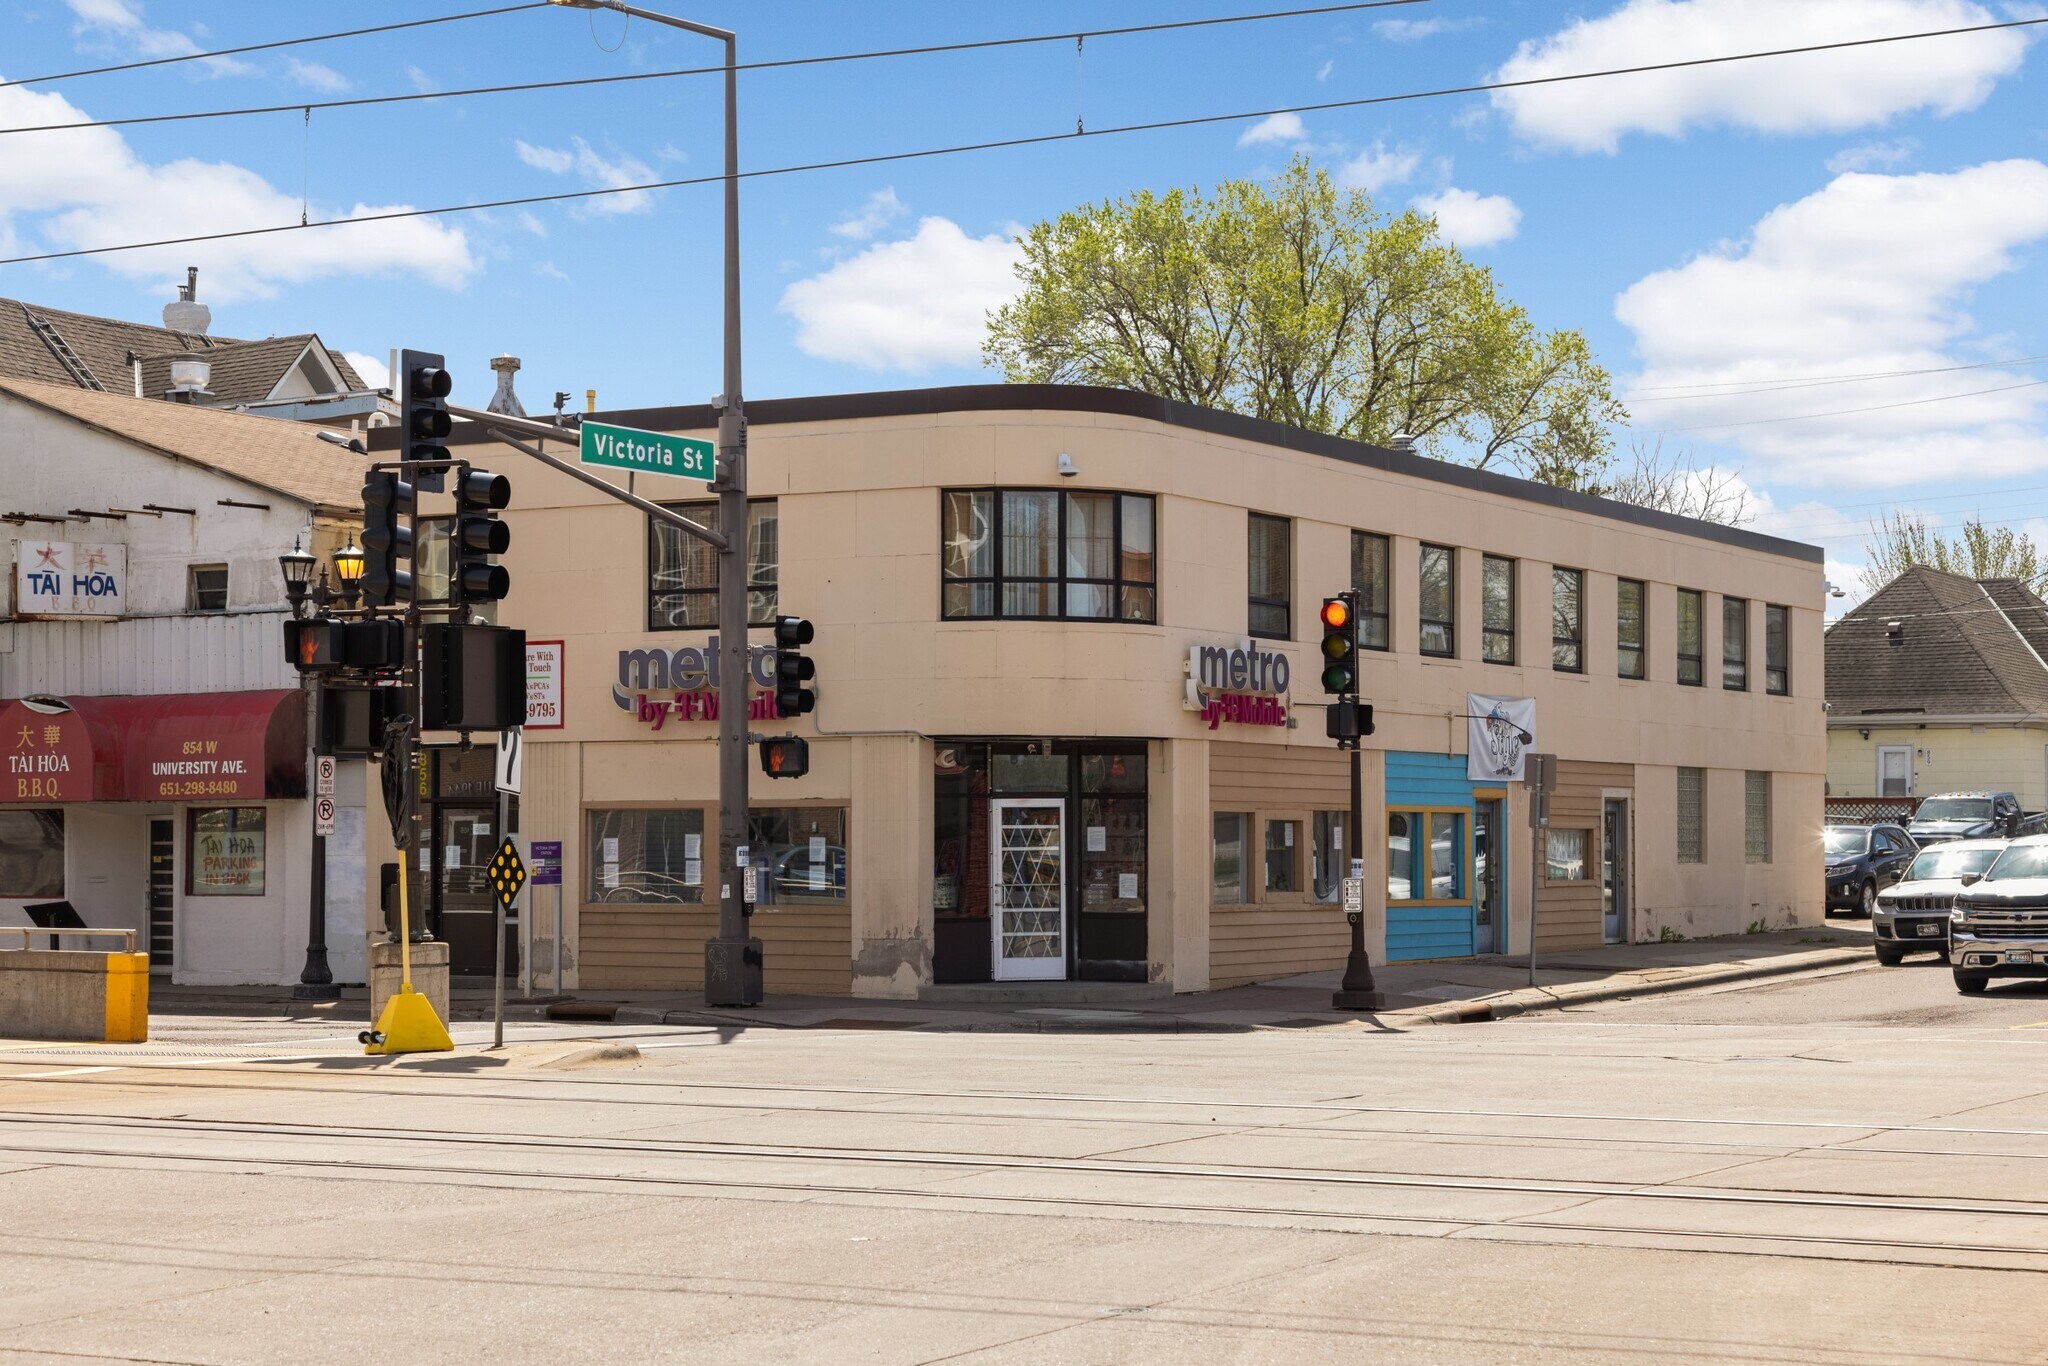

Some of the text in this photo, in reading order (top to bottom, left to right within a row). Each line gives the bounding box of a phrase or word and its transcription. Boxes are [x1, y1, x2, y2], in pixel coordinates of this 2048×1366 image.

[594, 433, 703, 471] Victoria St
[536, 652, 554, 661] With
[529, 663, 551, 673] Touch
[1200, 640, 1290, 693] metro
[637, 694, 671, 731] by
[17, 725, 61, 748] 大華
[182, 741, 218, 755] 854 W
[8, 750, 70, 773] TÀI HÒA
[153, 760, 247, 775] UNIVERSITY AVE.
[17, 778, 61, 799] B.B.Q.
[160, 781, 237, 795] 651-298-8480
[201, 836, 223, 855] TAI
[203, 856, 257, 871] PARKING
